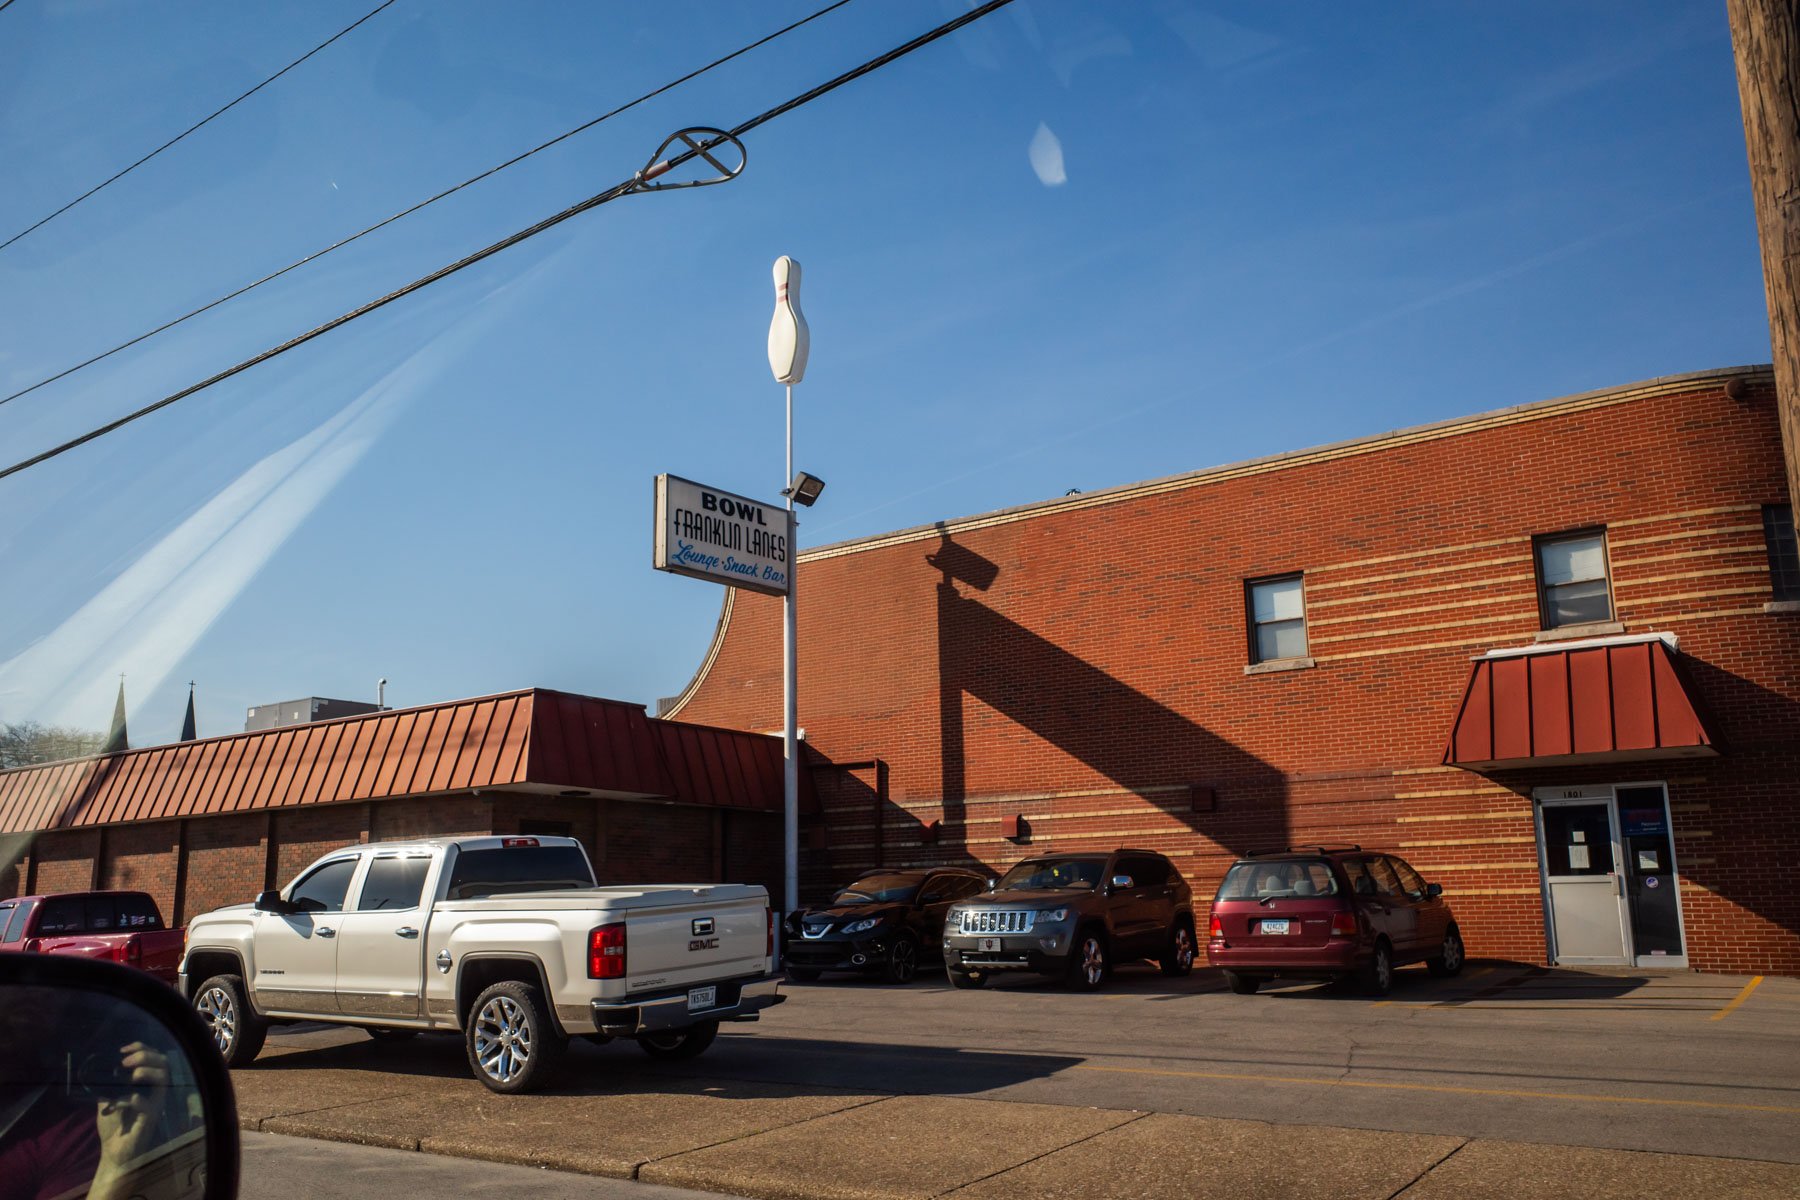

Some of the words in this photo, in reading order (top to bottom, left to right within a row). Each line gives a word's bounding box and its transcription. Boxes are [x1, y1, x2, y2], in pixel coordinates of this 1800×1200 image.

[701, 491, 767, 526] BOWL
[673, 508, 741, 552] FRANKLIN
[746, 526, 786, 562] LANES
[672, 539, 719, 571] Lounge
[762, 565, 787, 585] Bar
[1563, 791, 1582, 799] 1801
[688, 937, 720, 952] GMC
